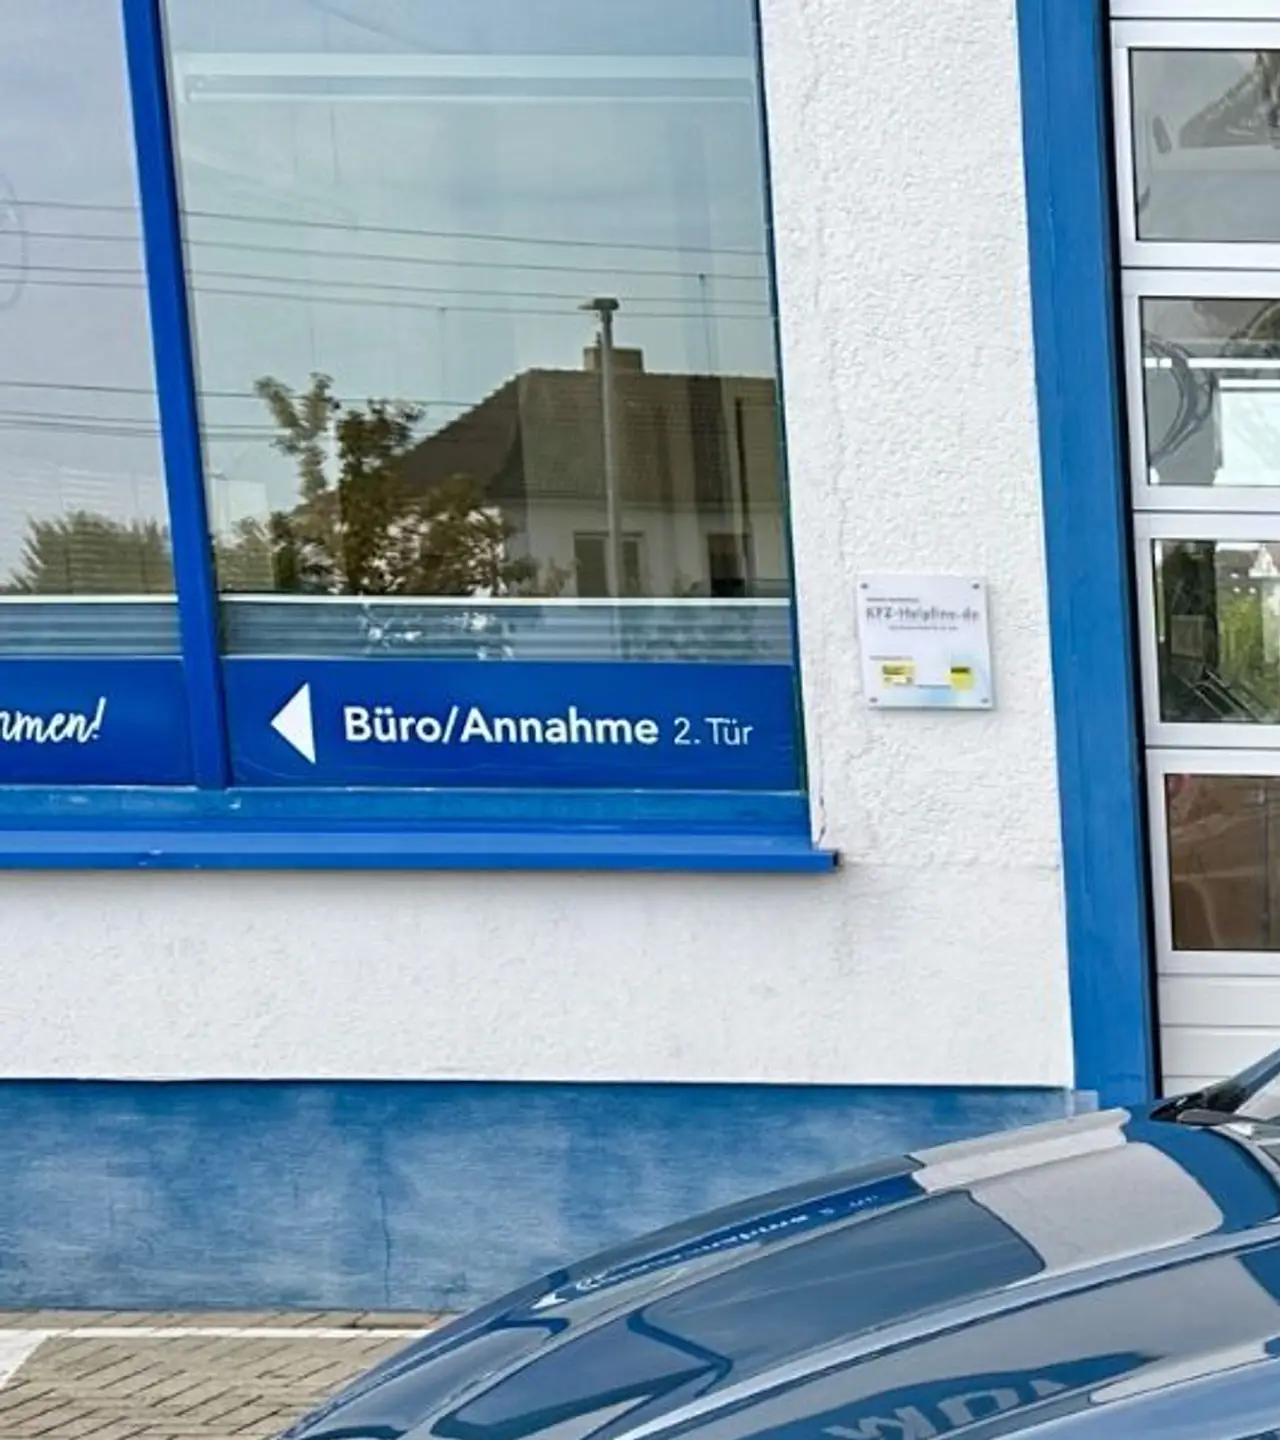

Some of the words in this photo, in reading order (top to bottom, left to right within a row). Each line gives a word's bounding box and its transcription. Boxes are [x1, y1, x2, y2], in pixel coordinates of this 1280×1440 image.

[343, 704, 660, 745] Büro/Annahme
[673, 717, 701, 746] 2.
[705, 716, 754, 747] Tür
